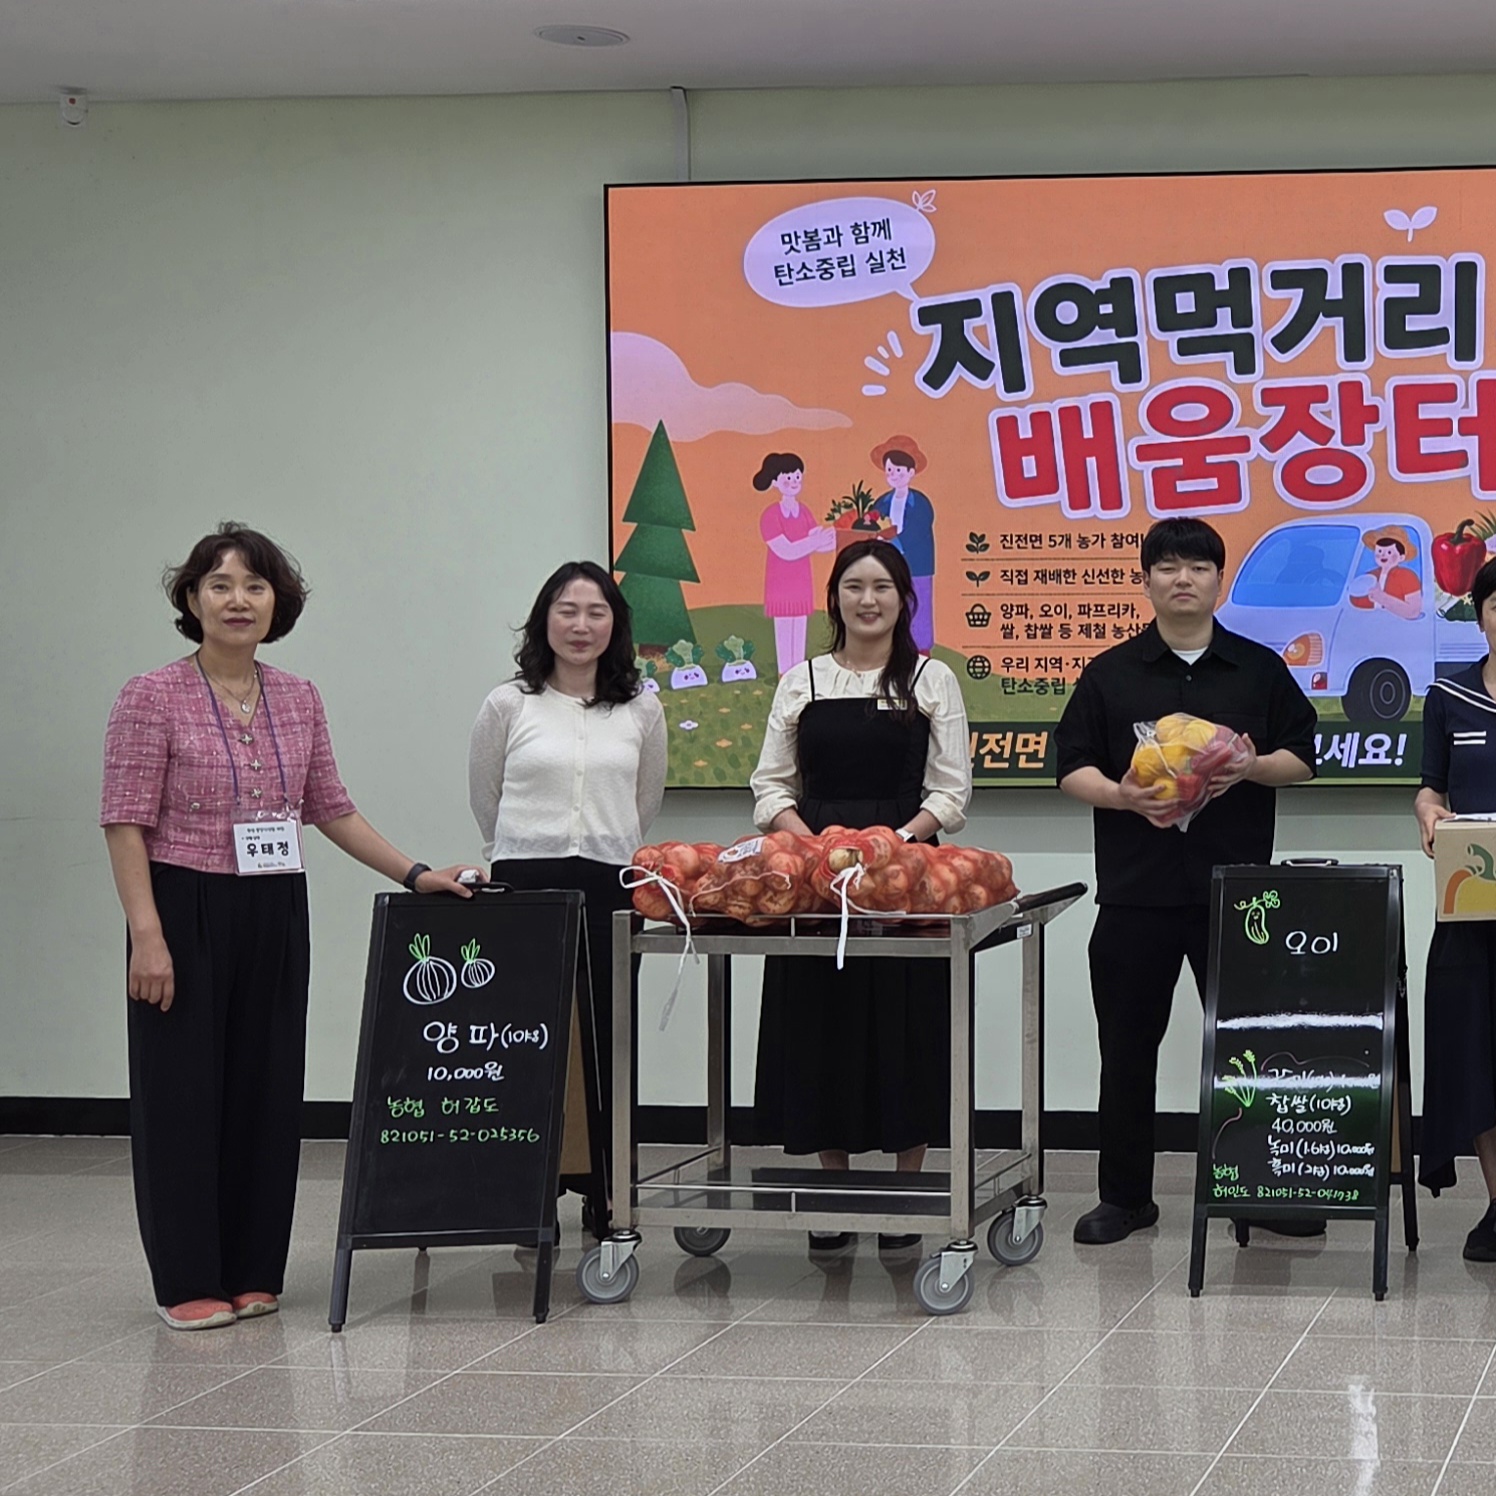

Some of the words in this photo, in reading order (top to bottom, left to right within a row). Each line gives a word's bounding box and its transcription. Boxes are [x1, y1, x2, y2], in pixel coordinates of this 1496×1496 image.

[779, 225, 844, 256] 맛봄과
[850, 217, 893, 245] 함께
[773, 254, 857, 287] 탄소중립
[865, 246, 908, 274] 실천
[916, 258, 1480, 396] 지역먹거리
[1000, 533, 1043, 550] 진전면
[1048, 533, 1072, 549] 5개
[1076, 533, 1106, 549] 농가
[1000, 569, 1028, 585] 직접
[1033, 568, 1077, 585] 재배한
[1081, 568, 1125, 585] 신선한
[1129, 568, 1144, 584] 농
[1000, 603, 1034, 620] 양파,
[1039, 603, 1072, 620] 오이,
[1077, 602, 1140, 620] 파프리카,
[1000, 623, 1019, 640] 쌀,
[1024, 623, 1053, 640] 찹쌀
[1058, 623, 1073, 639] 등
[1077, 622, 1107, 639] 제철
[1001, 656, 1029, 673] 우리
[1001, 677, 1066, 695] 탄소중립
[1314, 731, 1408, 769] 세요!
[1285, 930, 1338, 955] 오이
[427, 1060, 505, 1082] 10,000원
[387, 1096, 425, 1118] 농협
[1271, 1117, 1338, 1135] 40,000원
[1212, 1163, 1240, 1181] 농협
